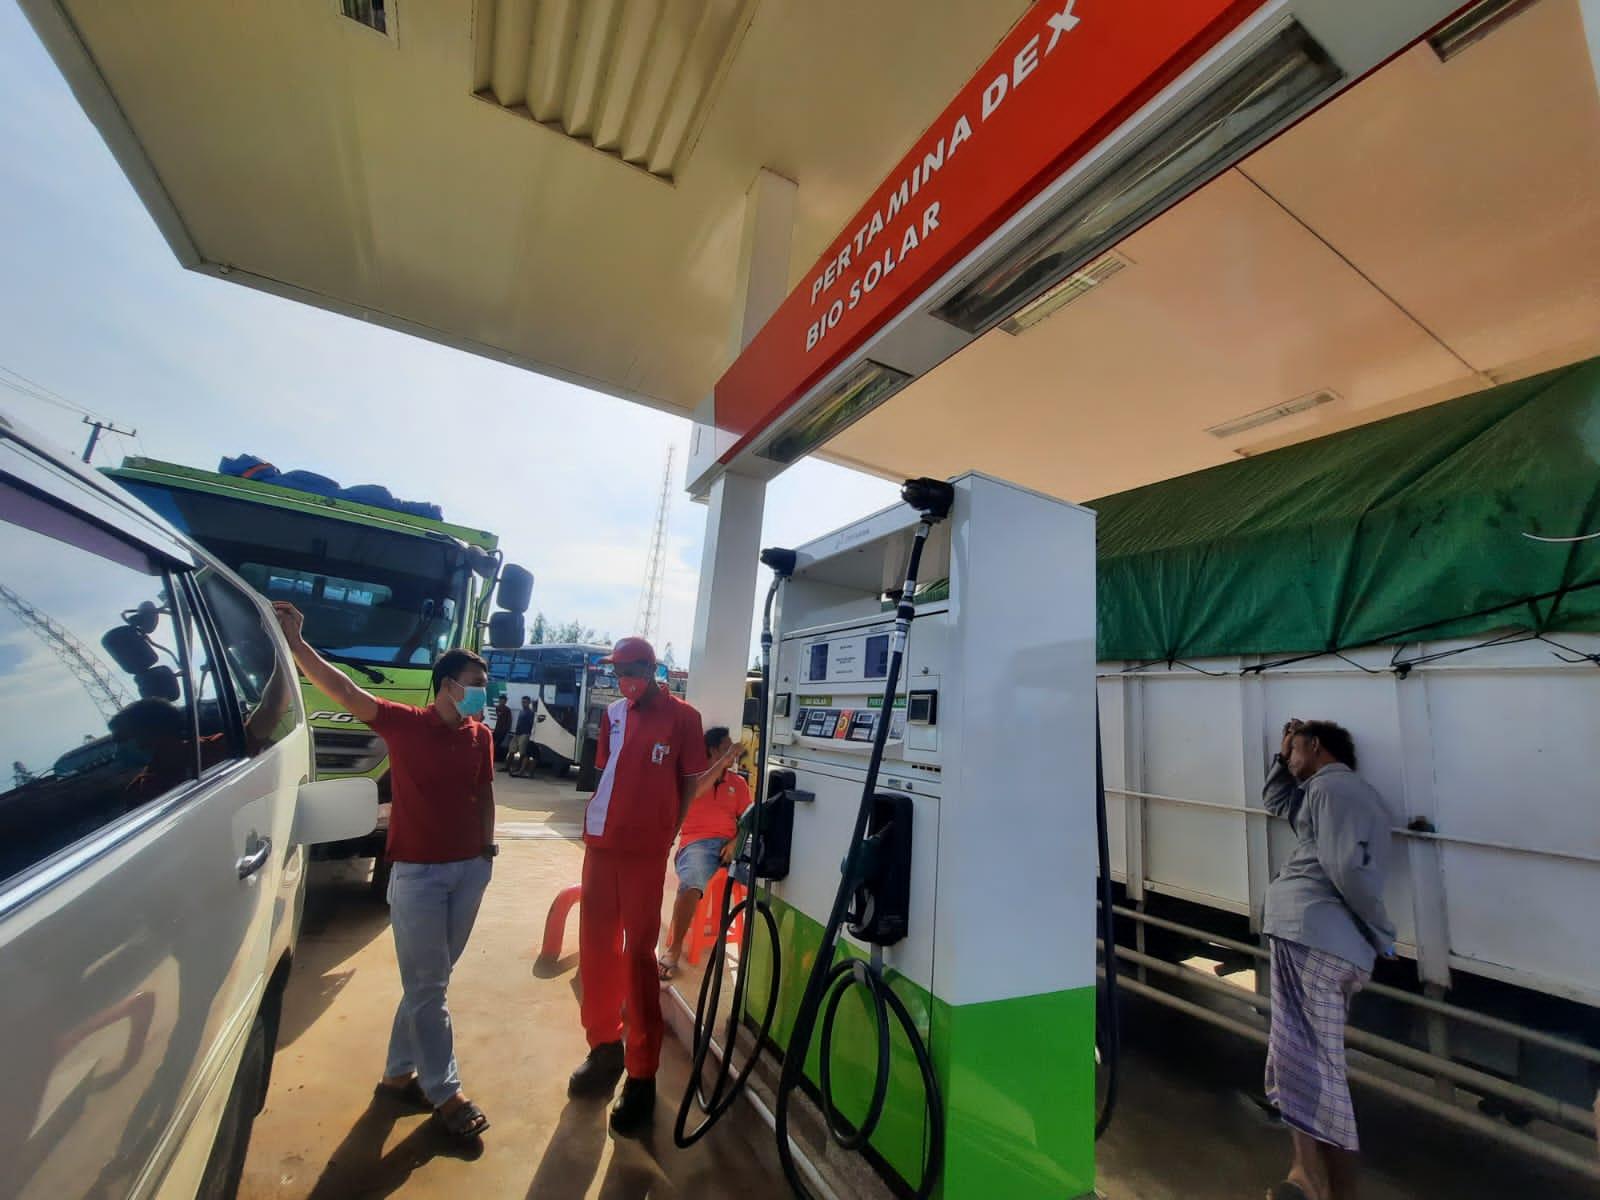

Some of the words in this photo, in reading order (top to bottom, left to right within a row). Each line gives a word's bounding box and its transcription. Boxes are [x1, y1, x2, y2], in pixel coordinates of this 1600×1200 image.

[810, 115, 972, 305] PERTAMINA
[981, 0, 1080, 121] DEX
[805, 299, 843, 352] BIO
[848, 201, 940, 310] SOLAR
[309, 711, 366, 724] FG
